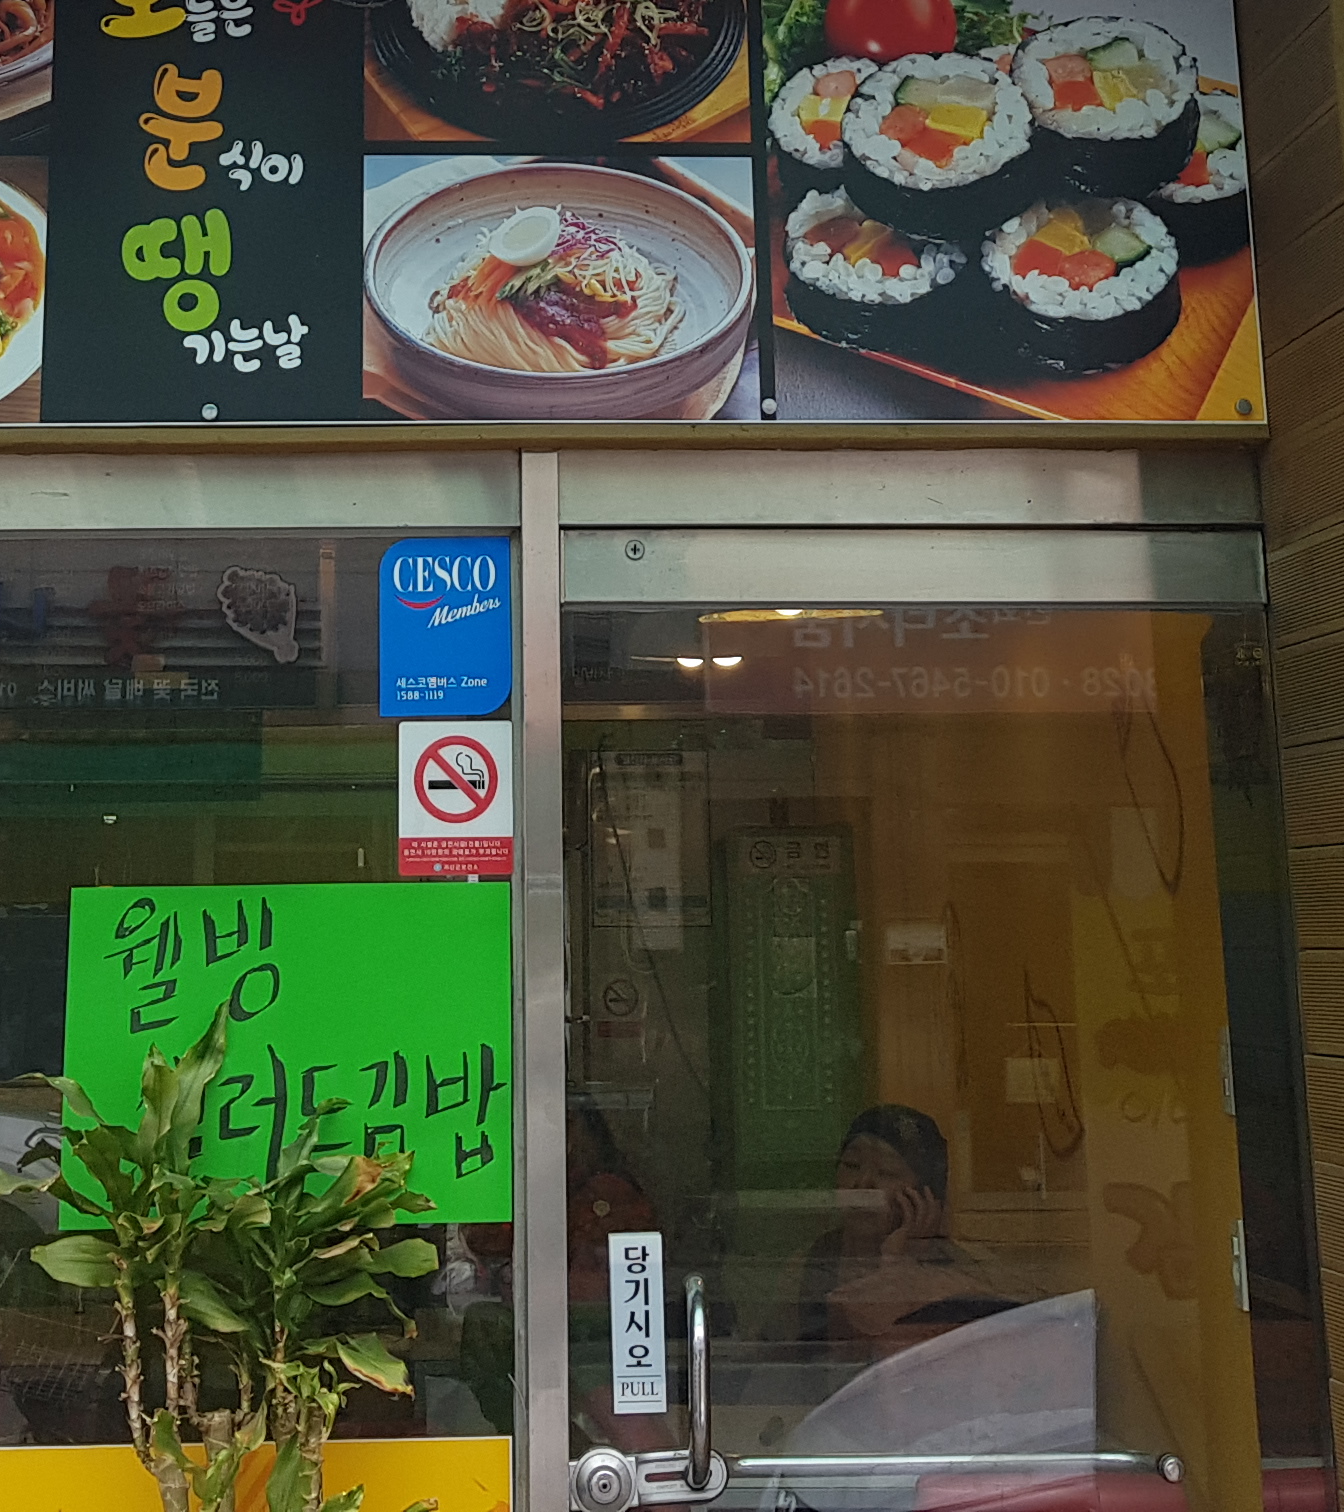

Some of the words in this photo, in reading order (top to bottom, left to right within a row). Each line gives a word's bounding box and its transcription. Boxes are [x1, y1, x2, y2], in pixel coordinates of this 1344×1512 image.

[139, 63, 304, 191] 분식이
[393, 555, 496, 592] CESCO
[426, 592, 502, 629] Members
[396, 690, 444, 701] 1588-1119
[460, 676, 488, 687] Zone
[104, 897, 280, 1034] 웰빙
[137, 1044, 508, 1185] 러드김밥
[623, 1245, 653, 1368] 당기시오
[620, 1381, 659, 1396] PULL
